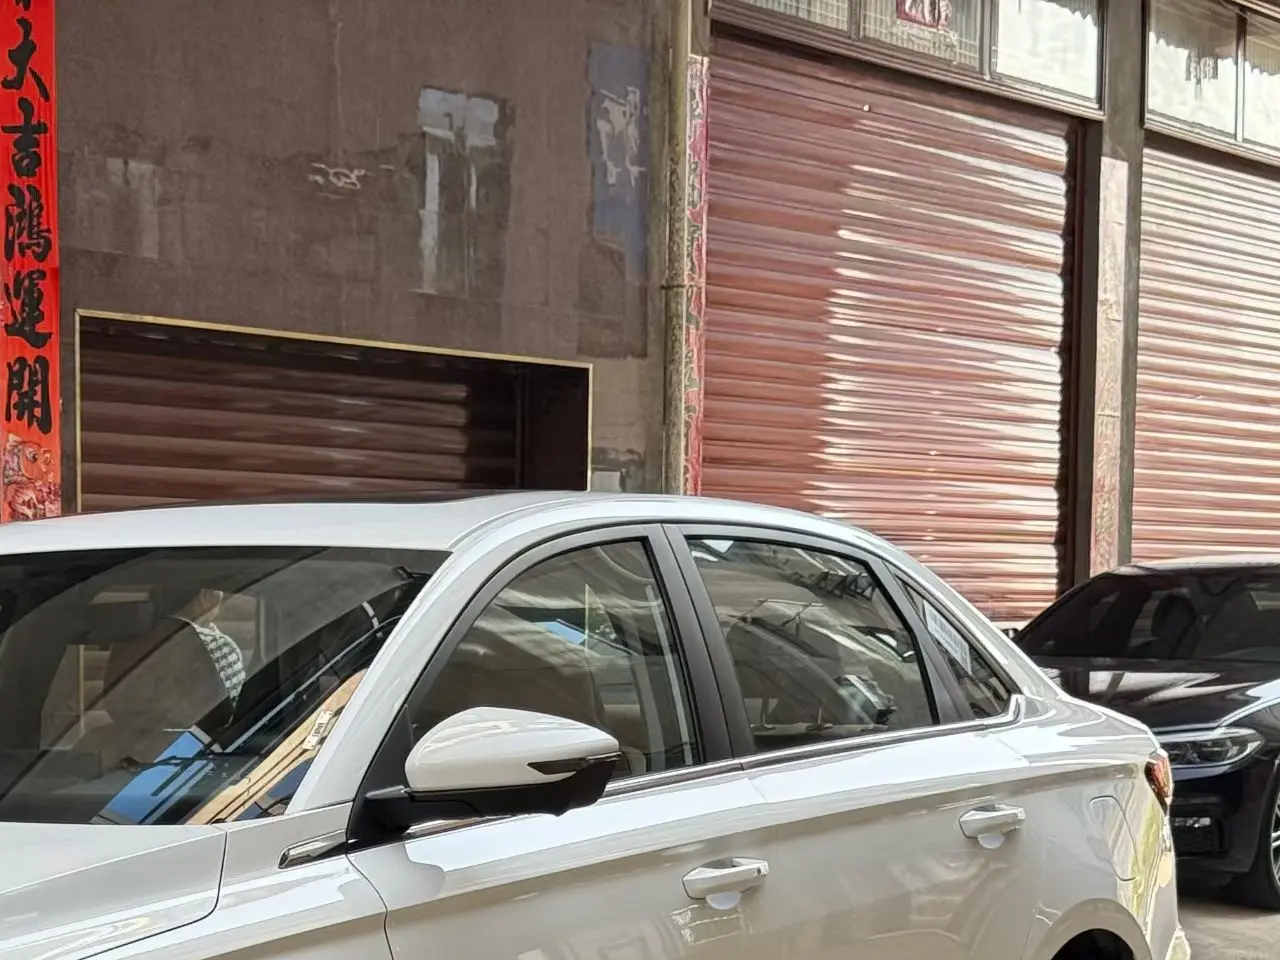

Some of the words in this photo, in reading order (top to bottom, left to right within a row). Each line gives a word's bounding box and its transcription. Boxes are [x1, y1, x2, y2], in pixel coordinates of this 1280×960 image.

[1, 0, 52, 434] 大吉鴻運開
